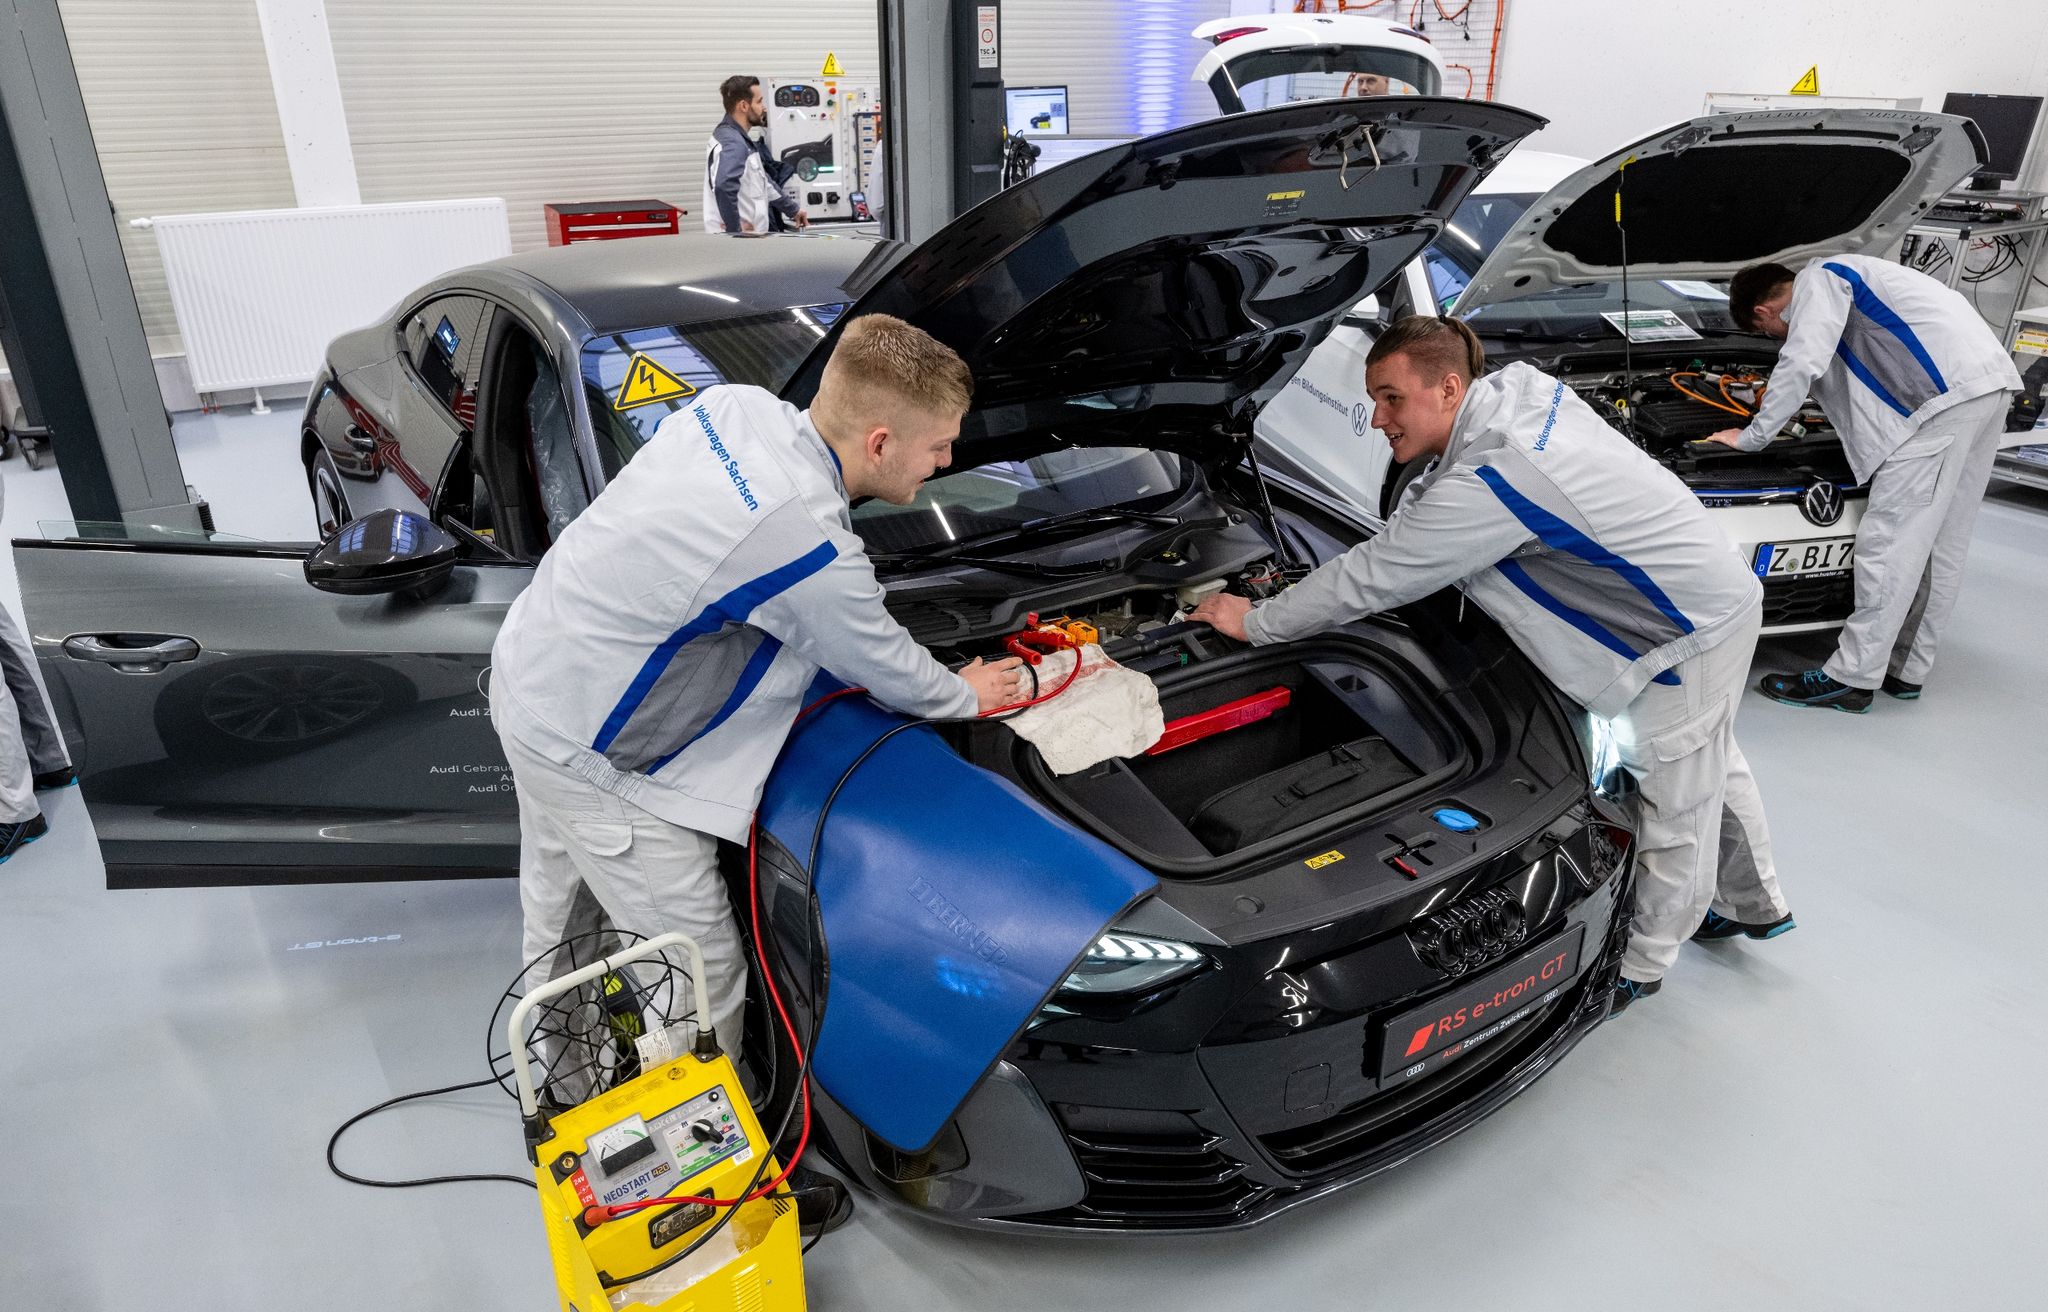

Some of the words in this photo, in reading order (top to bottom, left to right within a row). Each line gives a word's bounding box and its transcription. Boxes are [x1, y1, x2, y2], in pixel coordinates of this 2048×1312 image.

[1302, 378, 1349, 416] Bildungsinstitut
[693, 404, 731, 463] Volkswagen
[725, 461, 759, 511] Sachsen
[1769, 547, 1790, 572] Z
[449, 708, 480, 717] Audi
[430, 765, 460, 774] Audi
[468, 784, 498, 793] Audi
[1437, 1008, 1467, 1036] RS
[1472, 975, 1535, 1019] e-tron
[1540, 953, 1567, 980] GT
[1443, 1045, 1462, 1059] Audi
[1464, 1027, 1499, 1049] Zentrum
[1500, 1008, 1530, 1029] Zwickau
[573, 1175, 585, 1186] 24V
[603, 1172, 652, 1204] NEOSTART
[652, 1163, 671, 1177] 420
[582, 1194, 593, 1204] 12V
